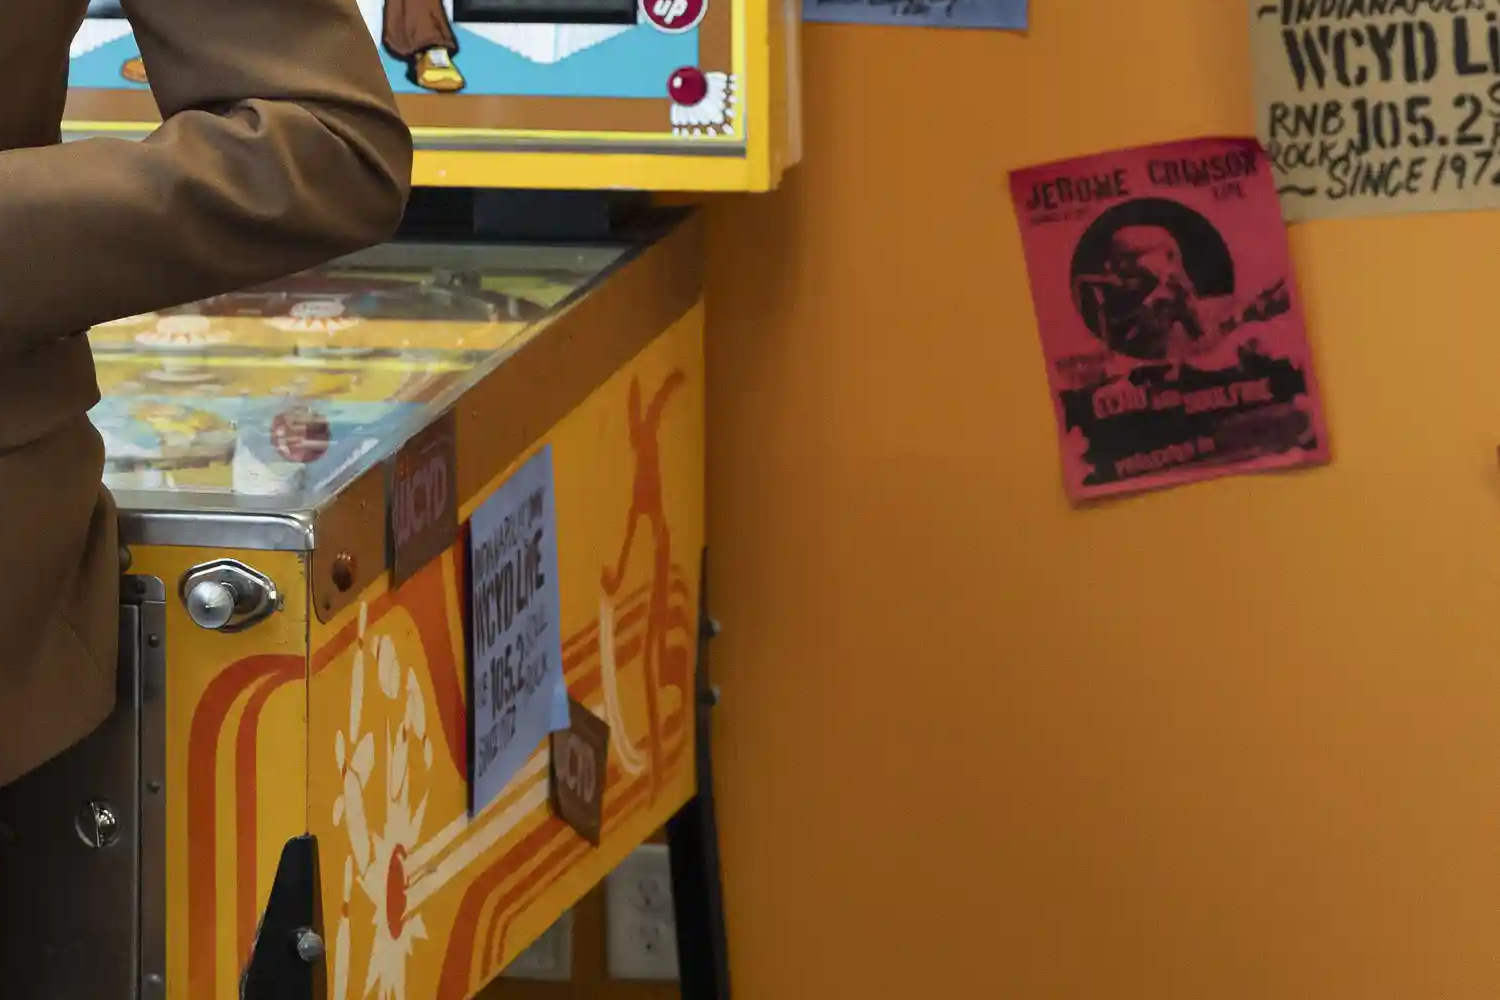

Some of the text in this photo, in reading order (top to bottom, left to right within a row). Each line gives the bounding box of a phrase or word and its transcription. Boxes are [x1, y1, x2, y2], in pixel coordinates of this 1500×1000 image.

[1282, 21, 1439, 91] WCYD
[1268, 99, 1345, 139] RNB
[1352, 93, 1484, 154] 105.2
[1325, 156, 1427, 199] SINCE
